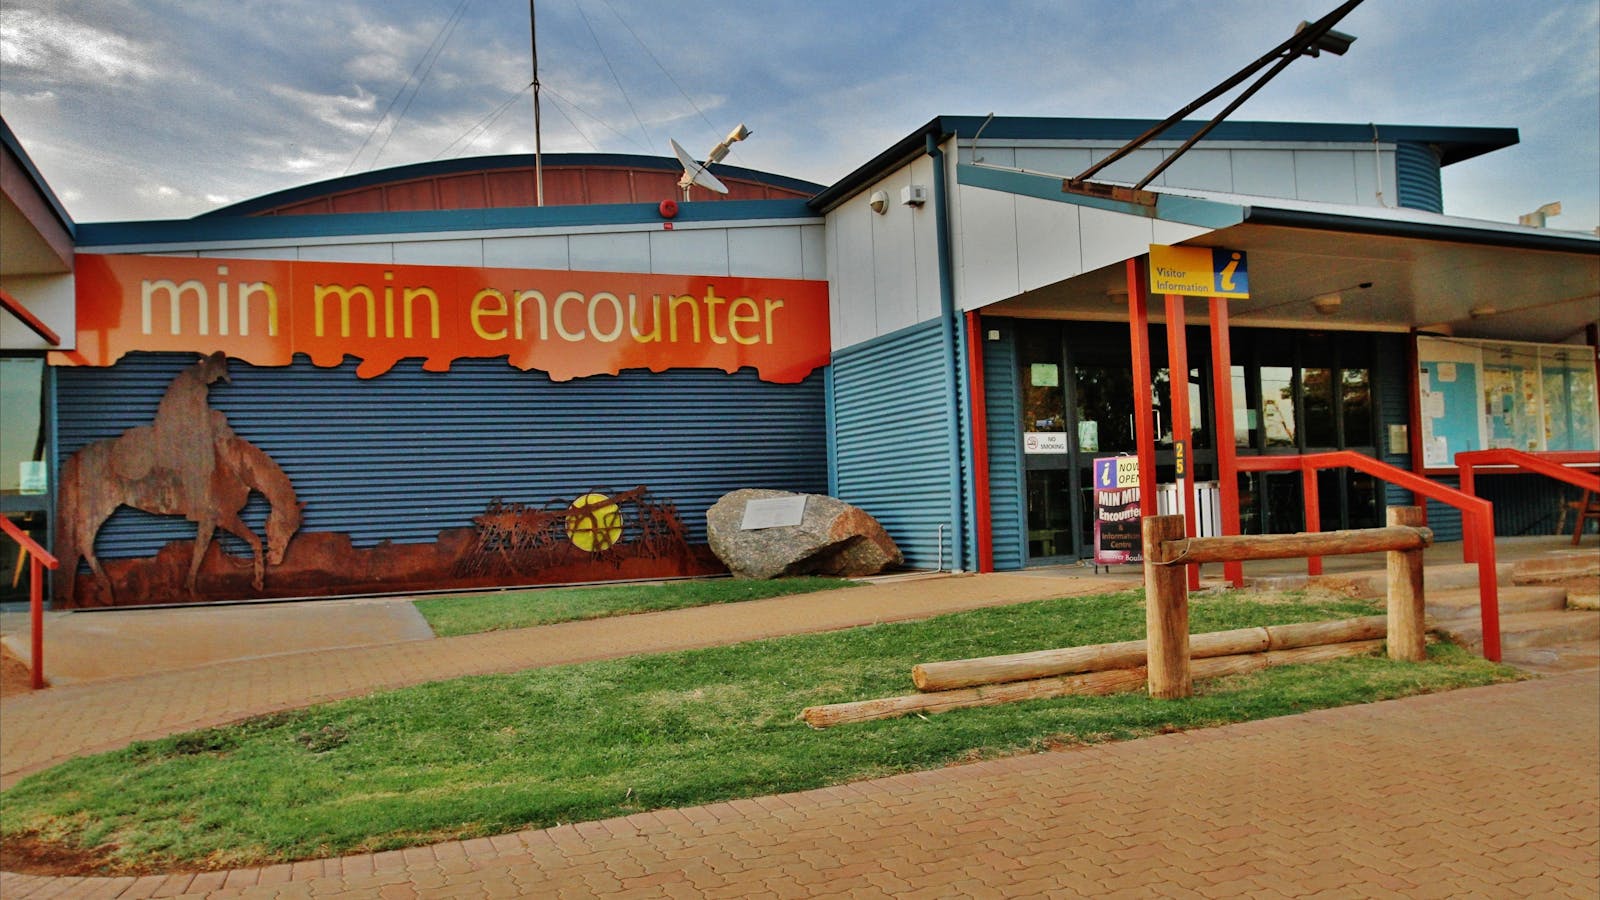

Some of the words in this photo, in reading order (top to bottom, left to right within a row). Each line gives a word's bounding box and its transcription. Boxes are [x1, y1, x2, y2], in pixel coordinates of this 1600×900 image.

[1156, 267, 1186, 278] Visitor
[1156, 281, 1209, 292] Information
[141, 266, 279, 336] min
[314, 270, 440, 338] min
[470, 284, 785, 345] encounter
[1098, 491, 1121, 507] MIN
